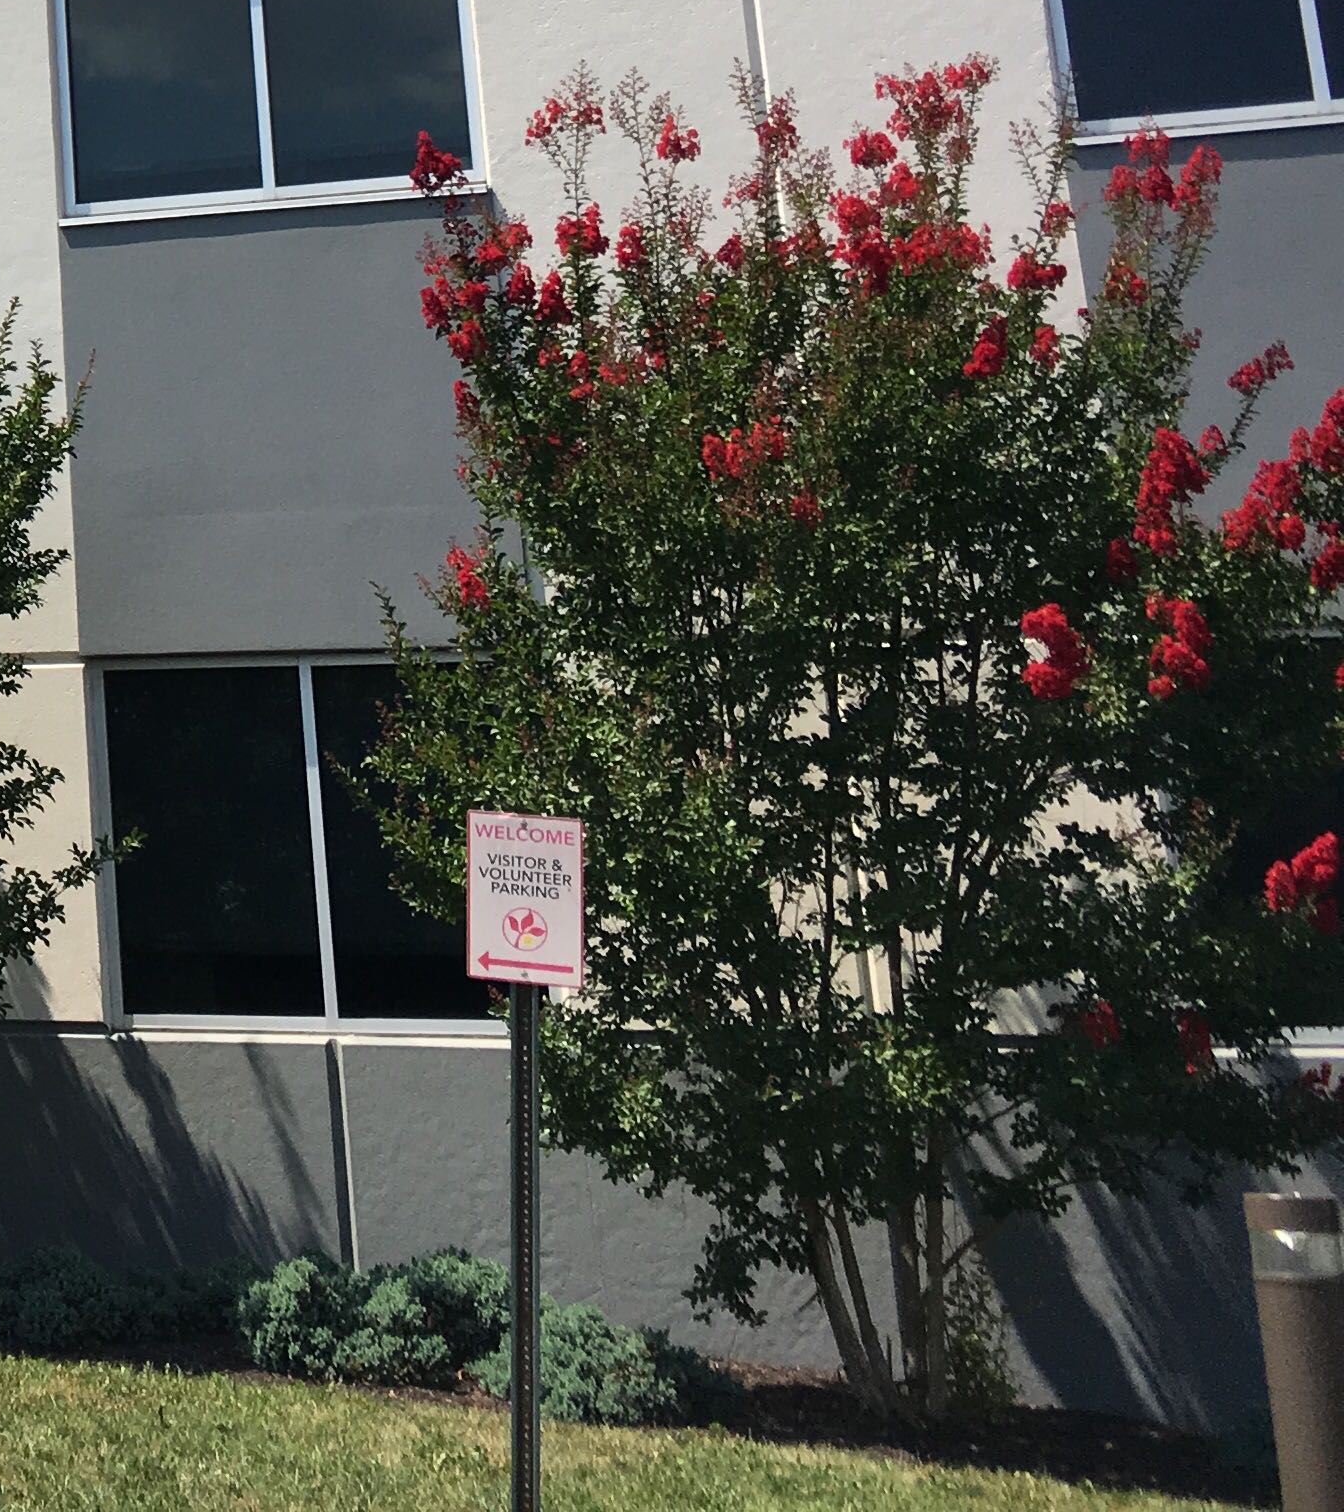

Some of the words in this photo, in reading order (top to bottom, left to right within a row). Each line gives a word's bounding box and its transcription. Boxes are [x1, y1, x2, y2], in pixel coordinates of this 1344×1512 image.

[475, 822, 575, 846] WELCOME
[487, 853, 547, 870] VISITOR
[551, 859, 563, 871] &
[479, 866, 572, 887] VOLUNTEER
[491, 883, 560, 900] PARKING
